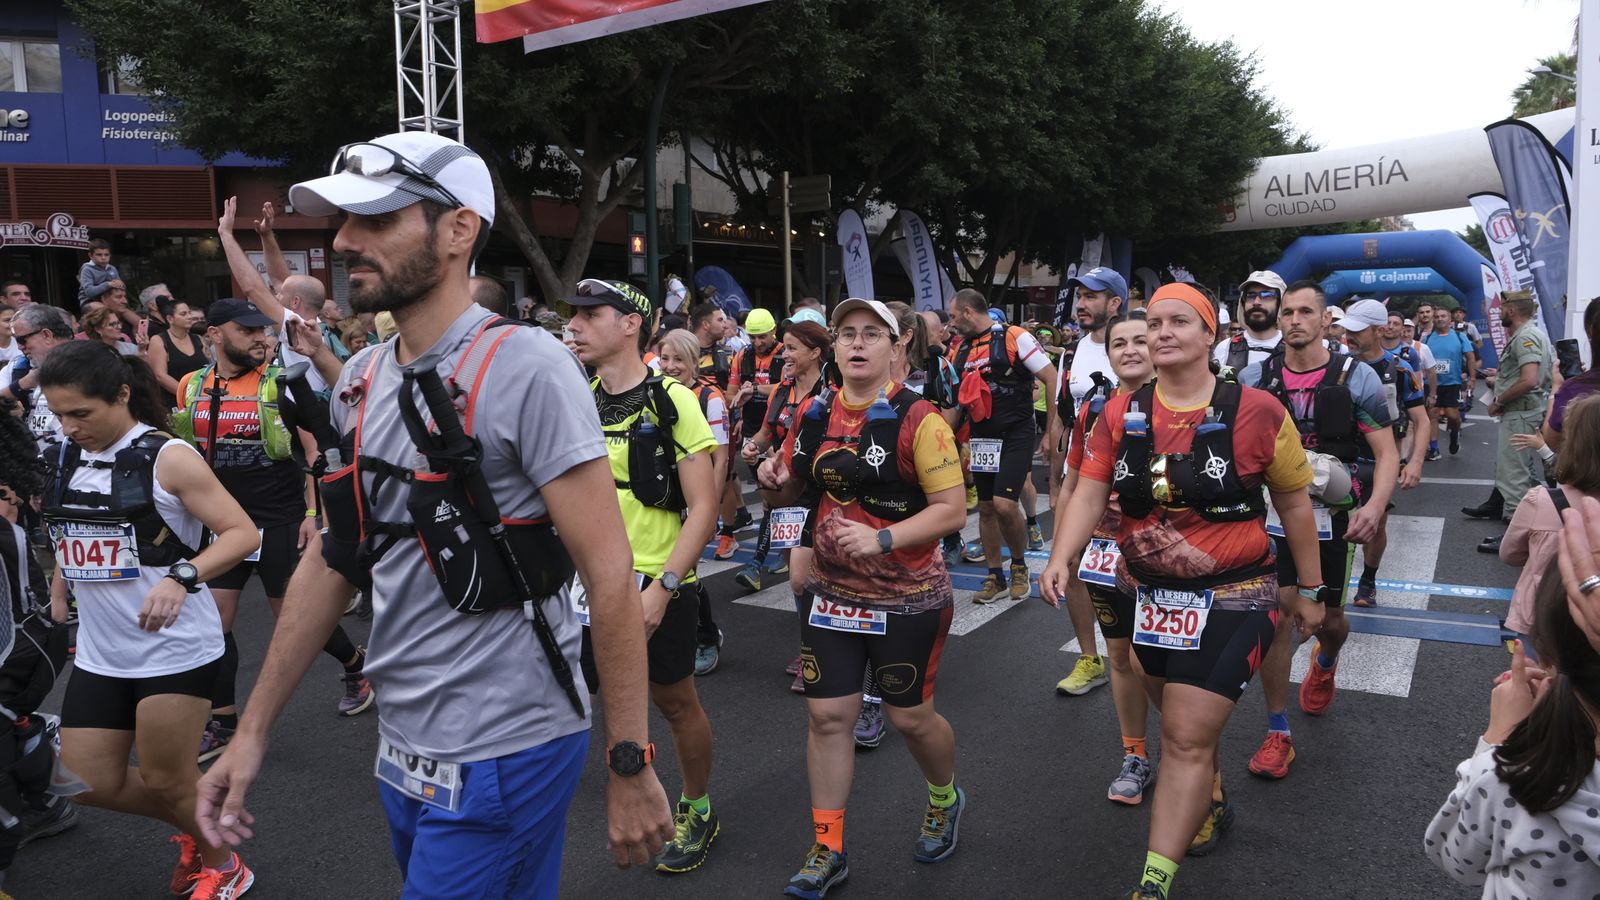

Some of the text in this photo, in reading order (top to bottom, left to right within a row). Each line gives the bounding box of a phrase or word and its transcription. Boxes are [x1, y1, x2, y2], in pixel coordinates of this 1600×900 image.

[1264, 156, 1408, 199] ALMERÍA
[1264, 198, 1336, 217] CIUDAD
[1380, 272, 1431, 284] cajamar
[233, 424, 260, 432] TEAM
[972, 453, 995, 465] 1393
[772, 524, 800, 541] 2639
[58, 539, 121, 567] 1047
[1085, 551, 1117, 573] 32
[1140, 605, 1199, 636] 3250
